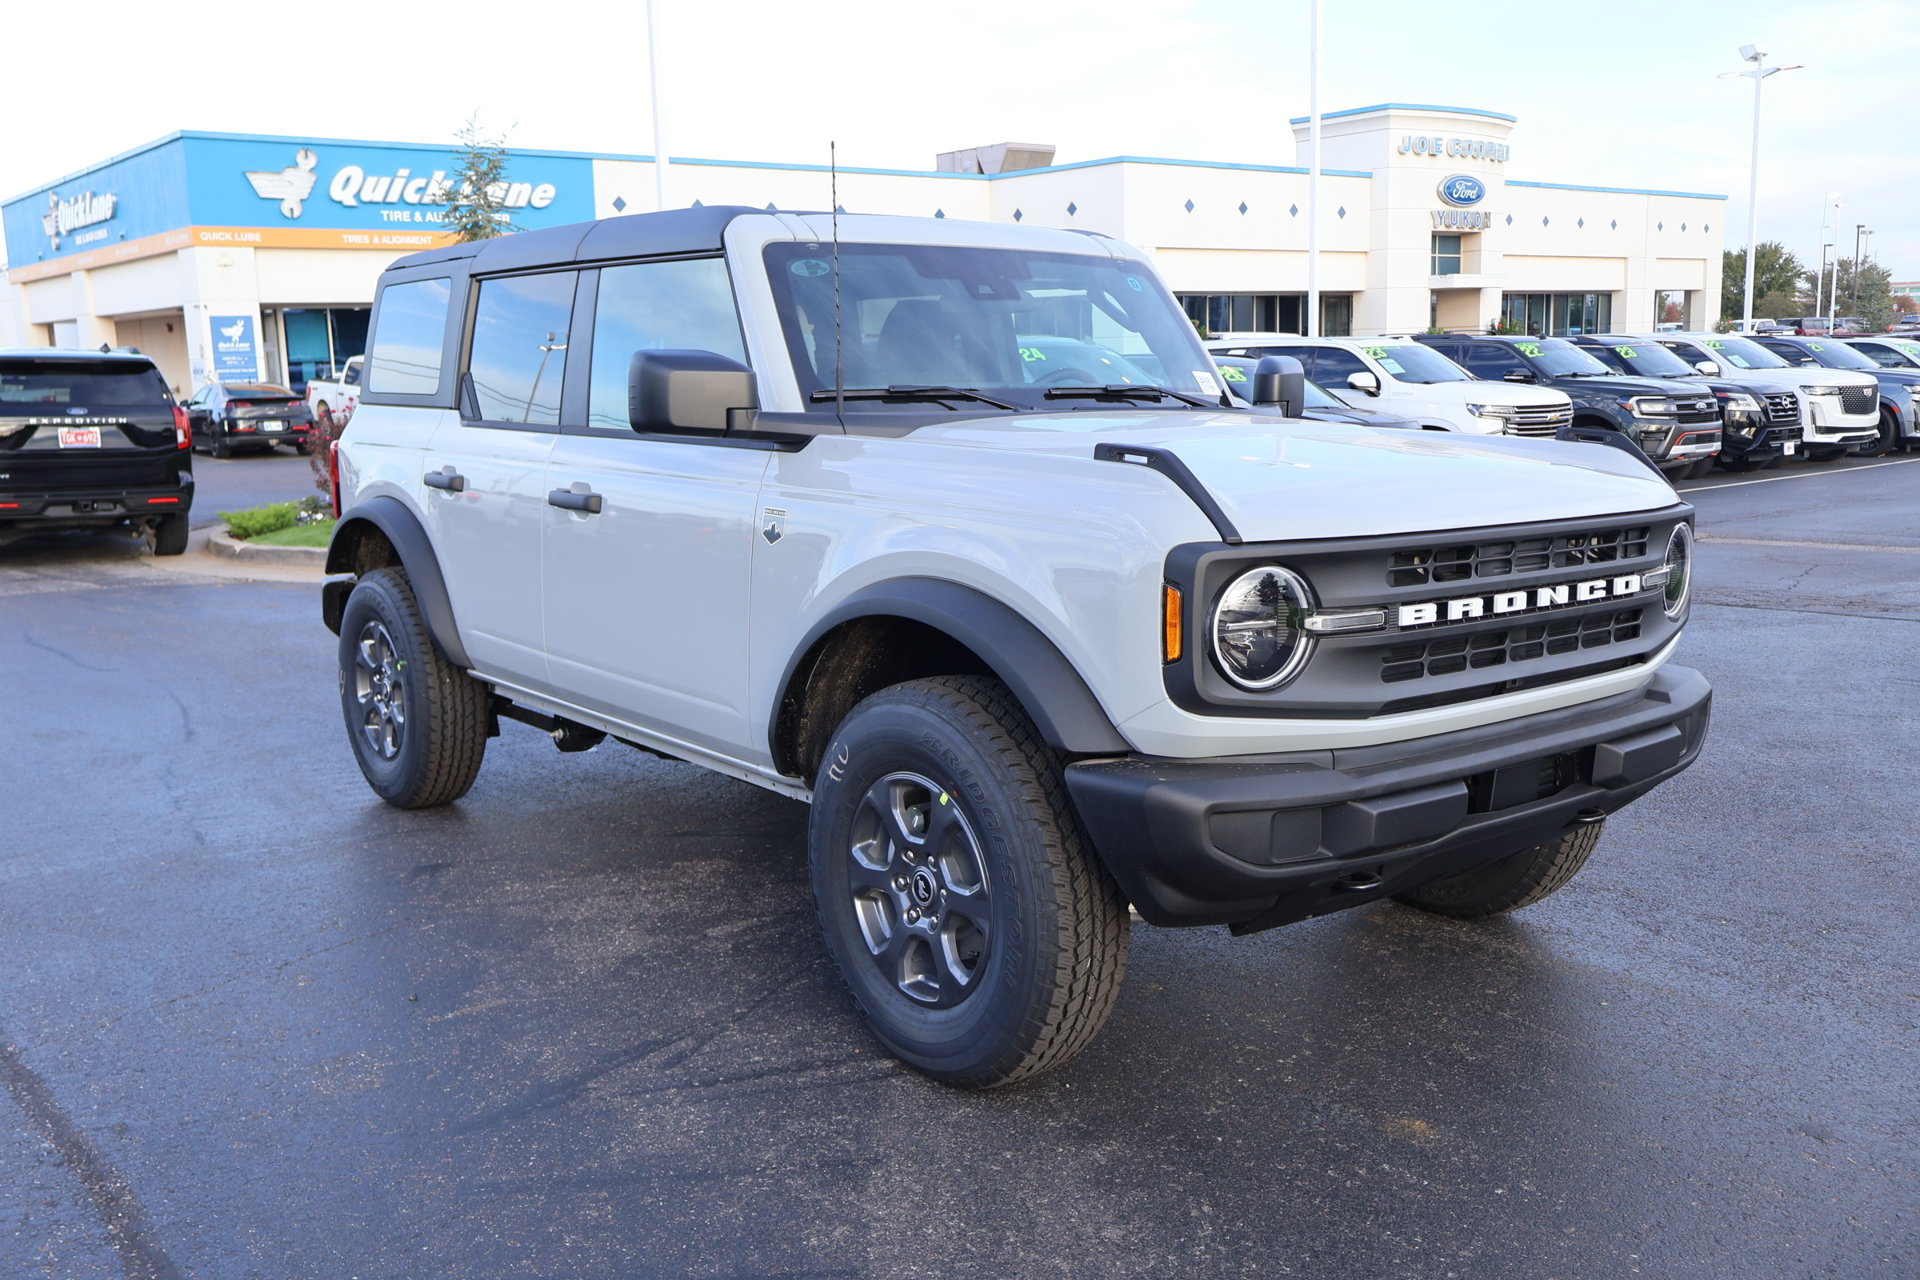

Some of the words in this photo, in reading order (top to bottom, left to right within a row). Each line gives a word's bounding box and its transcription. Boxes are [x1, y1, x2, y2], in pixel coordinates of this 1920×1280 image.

[1398, 135, 1444, 156] JOE
[329, 165, 456, 207] Quick
[1452, 180, 1479, 199] Ford
[381, 210, 411, 222] TIRE
[414, 211, 423, 222] &
[1430, 210, 1491, 229] YUKON
[200, 232, 231, 242] QUICK
[234, 233, 261, 242] LUBE
[342, 234, 369, 244] TIRES
[373, 235, 380, 244] &
[382, 235, 432, 245] ALIGNMENT
[1019, 347, 1047, 362] 24
[1519, 344, 1545, 358] 22
[1399, 574, 1641, 627] BRONCO
